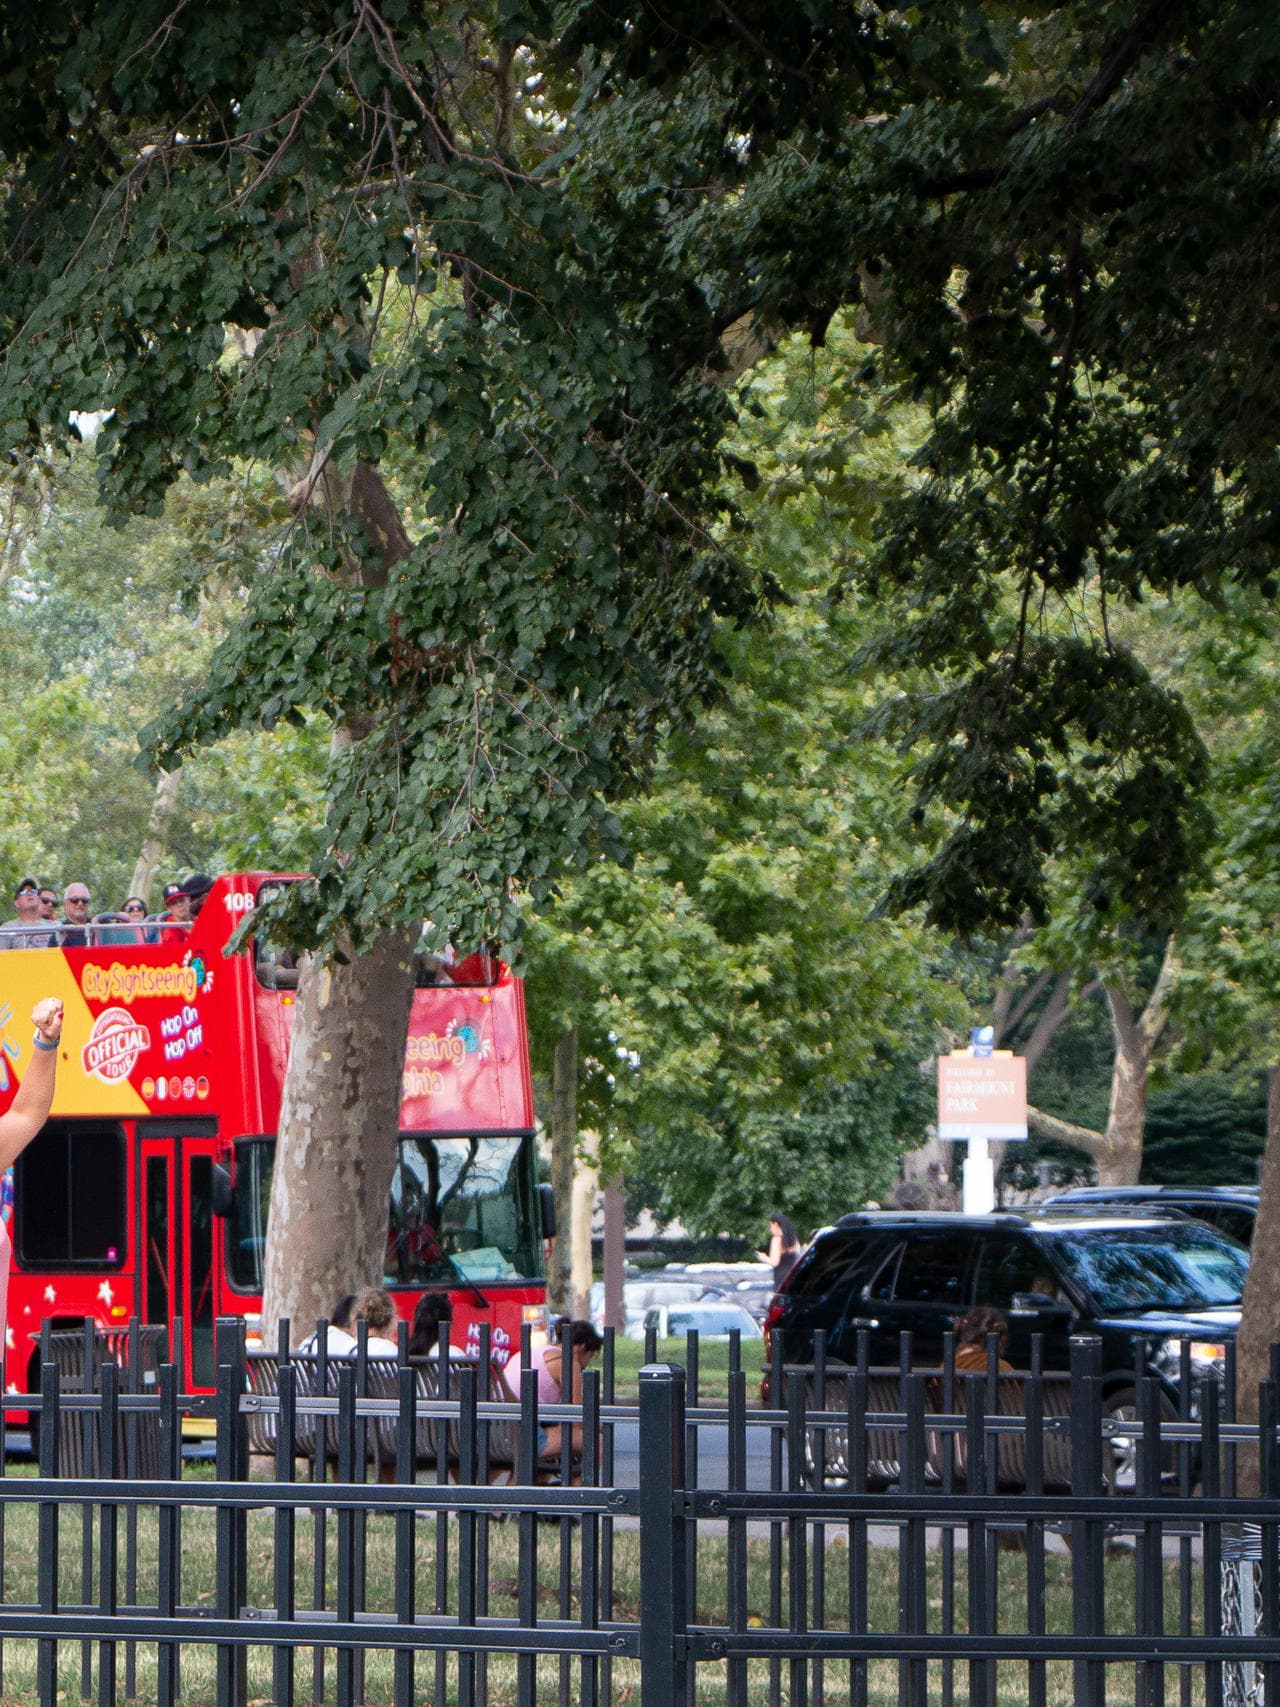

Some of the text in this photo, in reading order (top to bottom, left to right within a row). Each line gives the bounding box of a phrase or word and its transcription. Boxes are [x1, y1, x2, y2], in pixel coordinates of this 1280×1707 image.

[224, 893, 254, 912] 108
[183, 1006, 199, 1027] On
[187, 1025, 203, 1049] Off
[88, 1030, 146, 1067] OFFICIAL
[106, 1056, 132, 1077] TOUR
